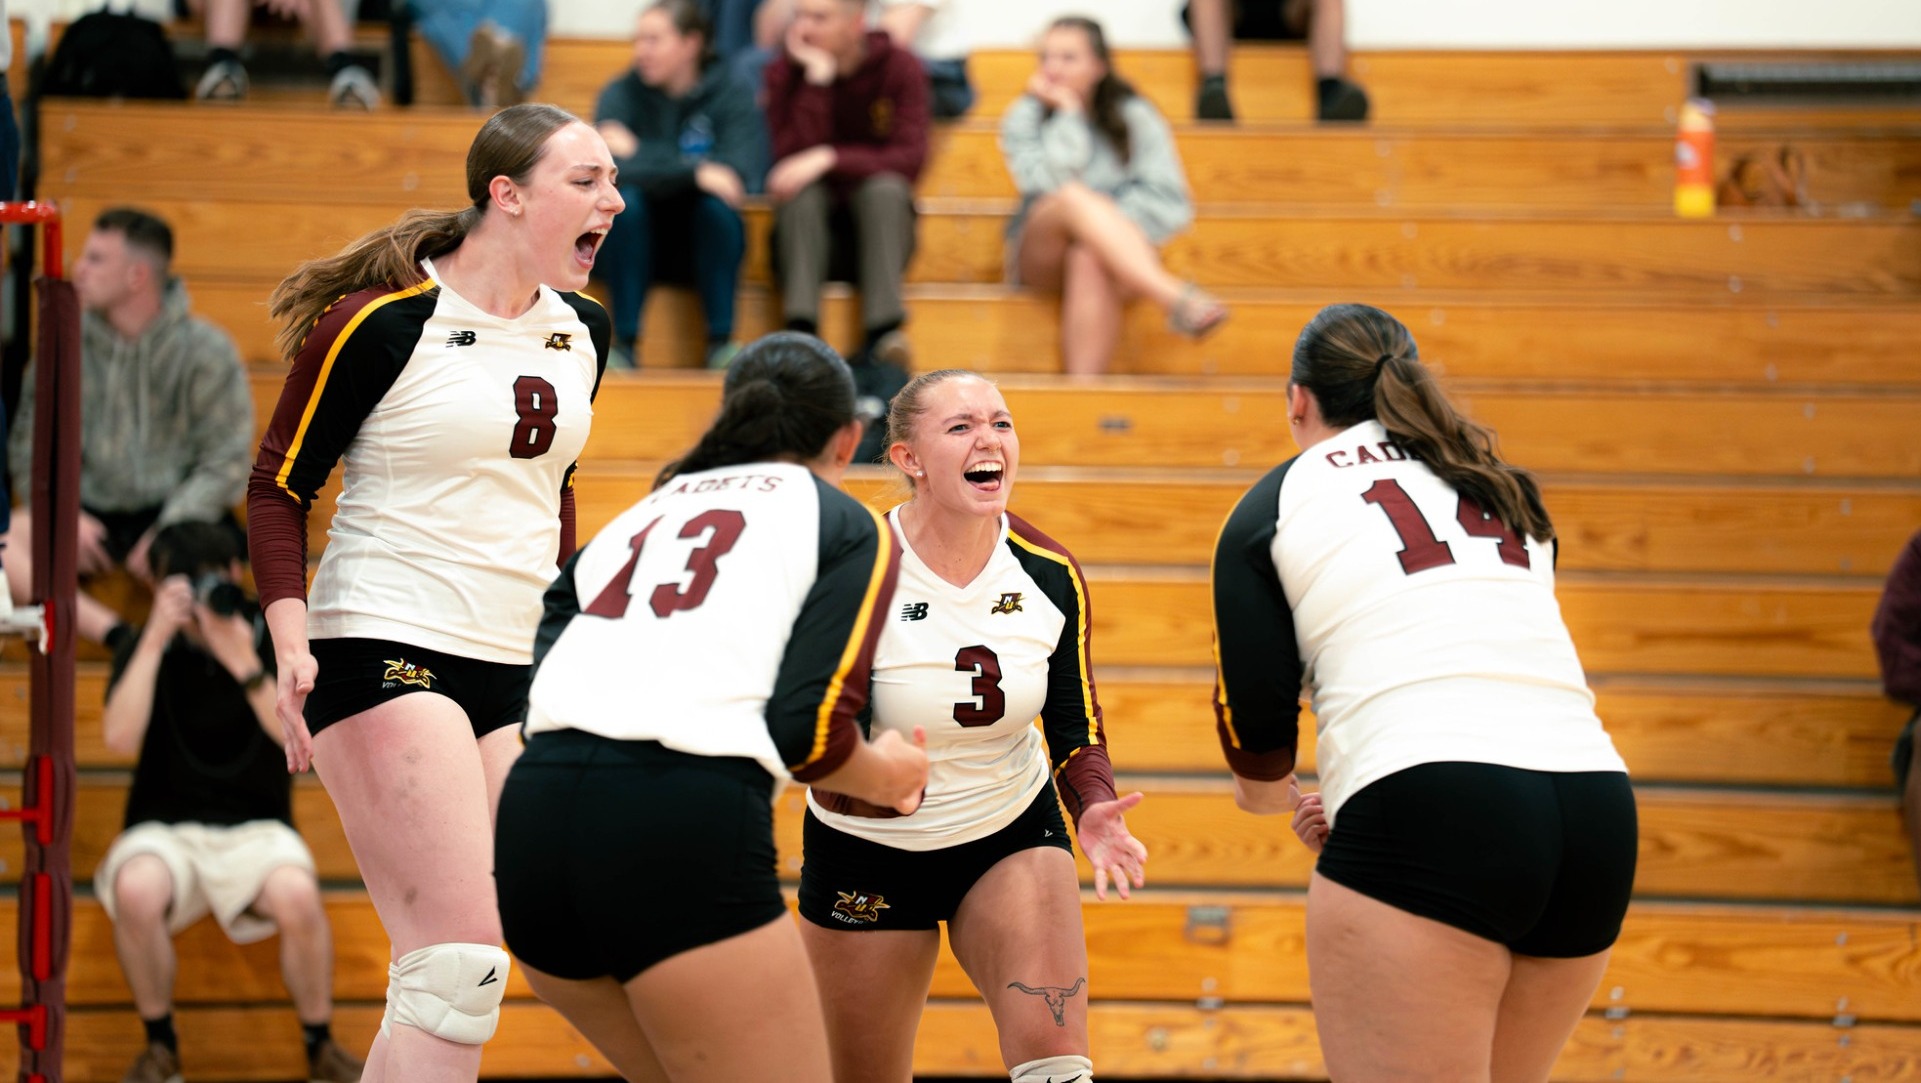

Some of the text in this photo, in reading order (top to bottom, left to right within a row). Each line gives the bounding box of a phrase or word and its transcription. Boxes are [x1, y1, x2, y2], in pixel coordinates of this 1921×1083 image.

[509, 375, 559, 459] 8
[651, 474, 785, 504] ADETS
[1360, 478, 1531, 576] 14
[583, 508, 747, 620] 13
[953, 644, 1006, 728] 3
